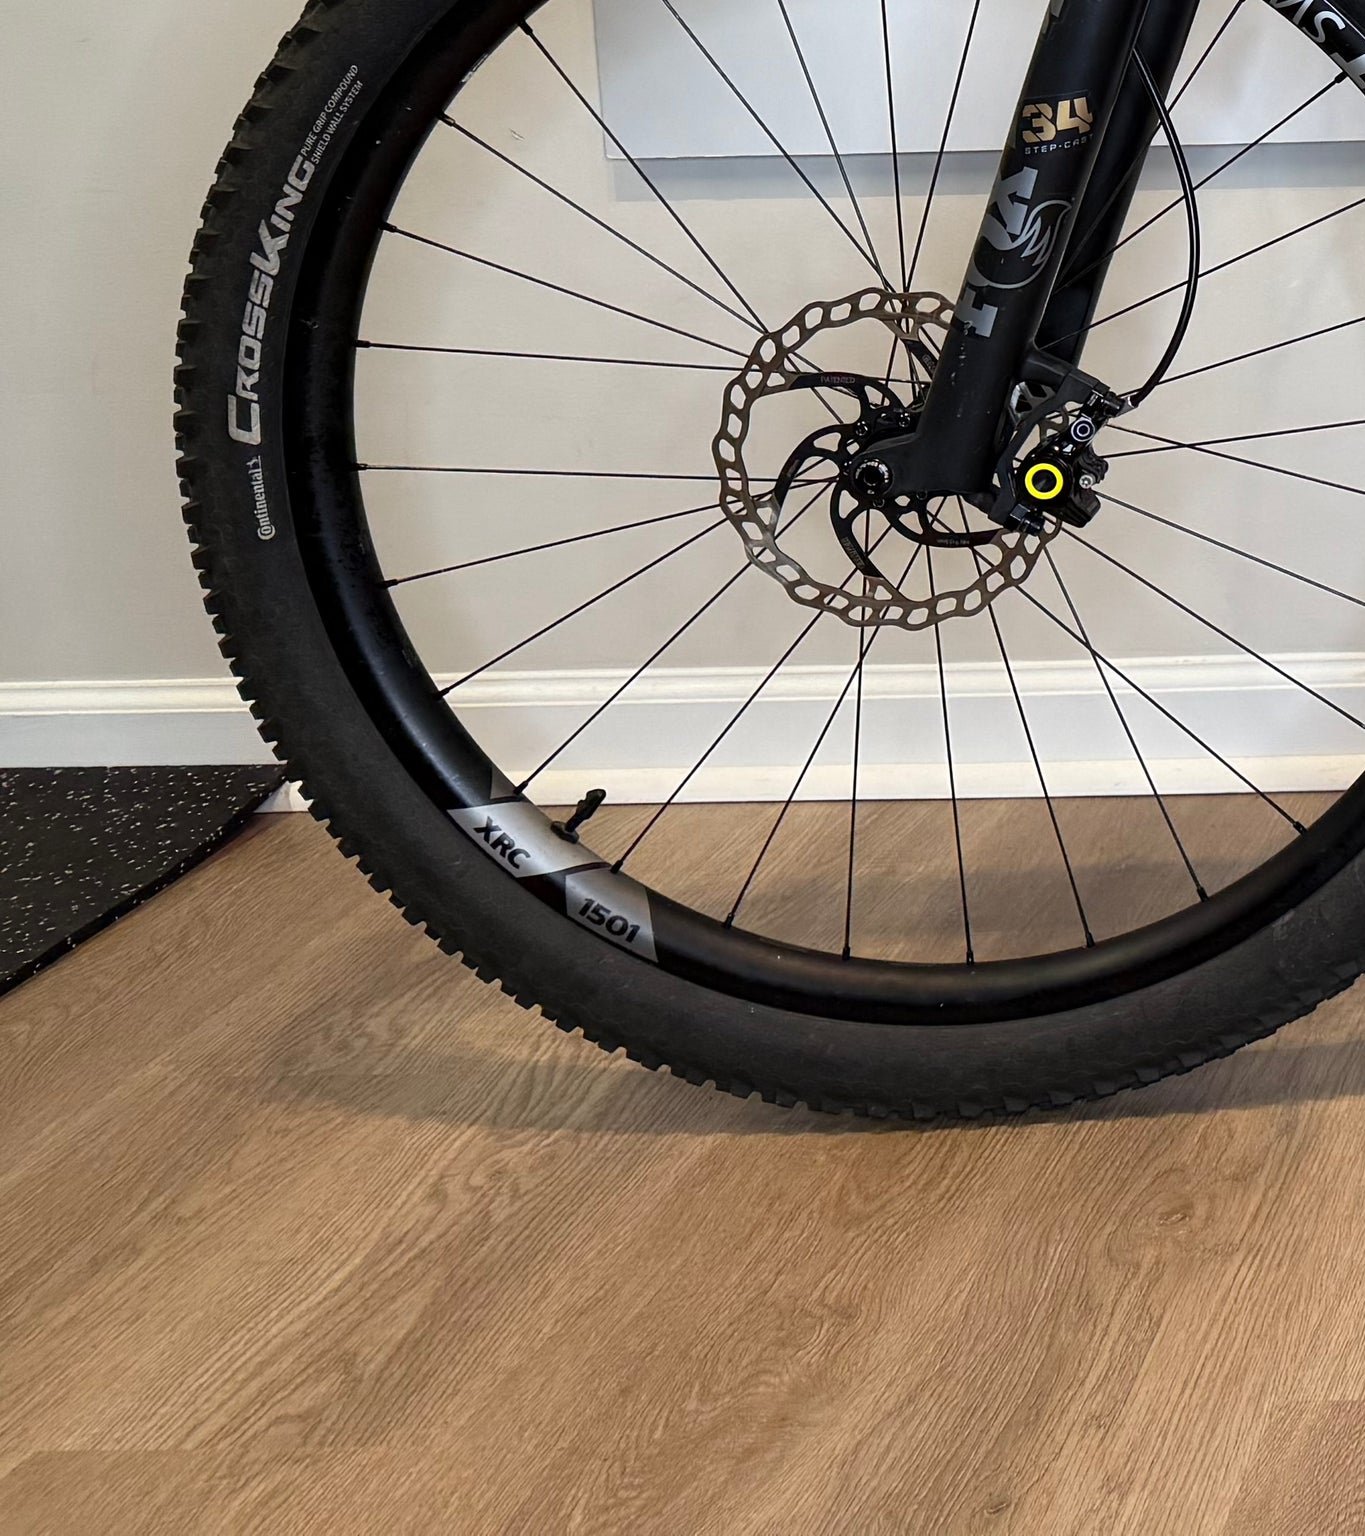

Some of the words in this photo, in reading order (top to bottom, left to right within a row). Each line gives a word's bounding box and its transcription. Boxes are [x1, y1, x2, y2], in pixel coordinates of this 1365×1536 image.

[300, 131, 317, 157] PURE
[312, 111, 328, 133] GRIP
[324, 64, 358, 113] COMPOUND
[310, 133, 331, 165] SHIELD
[326, 112, 344, 134] WALL
[340, 80, 363, 113] SYSTEM
[1022, 97, 1094, 144] 34
[246, 467, 275, 543] Continental
[473, 816, 531, 870] XRC
[578, 897, 641, 943] 1501
